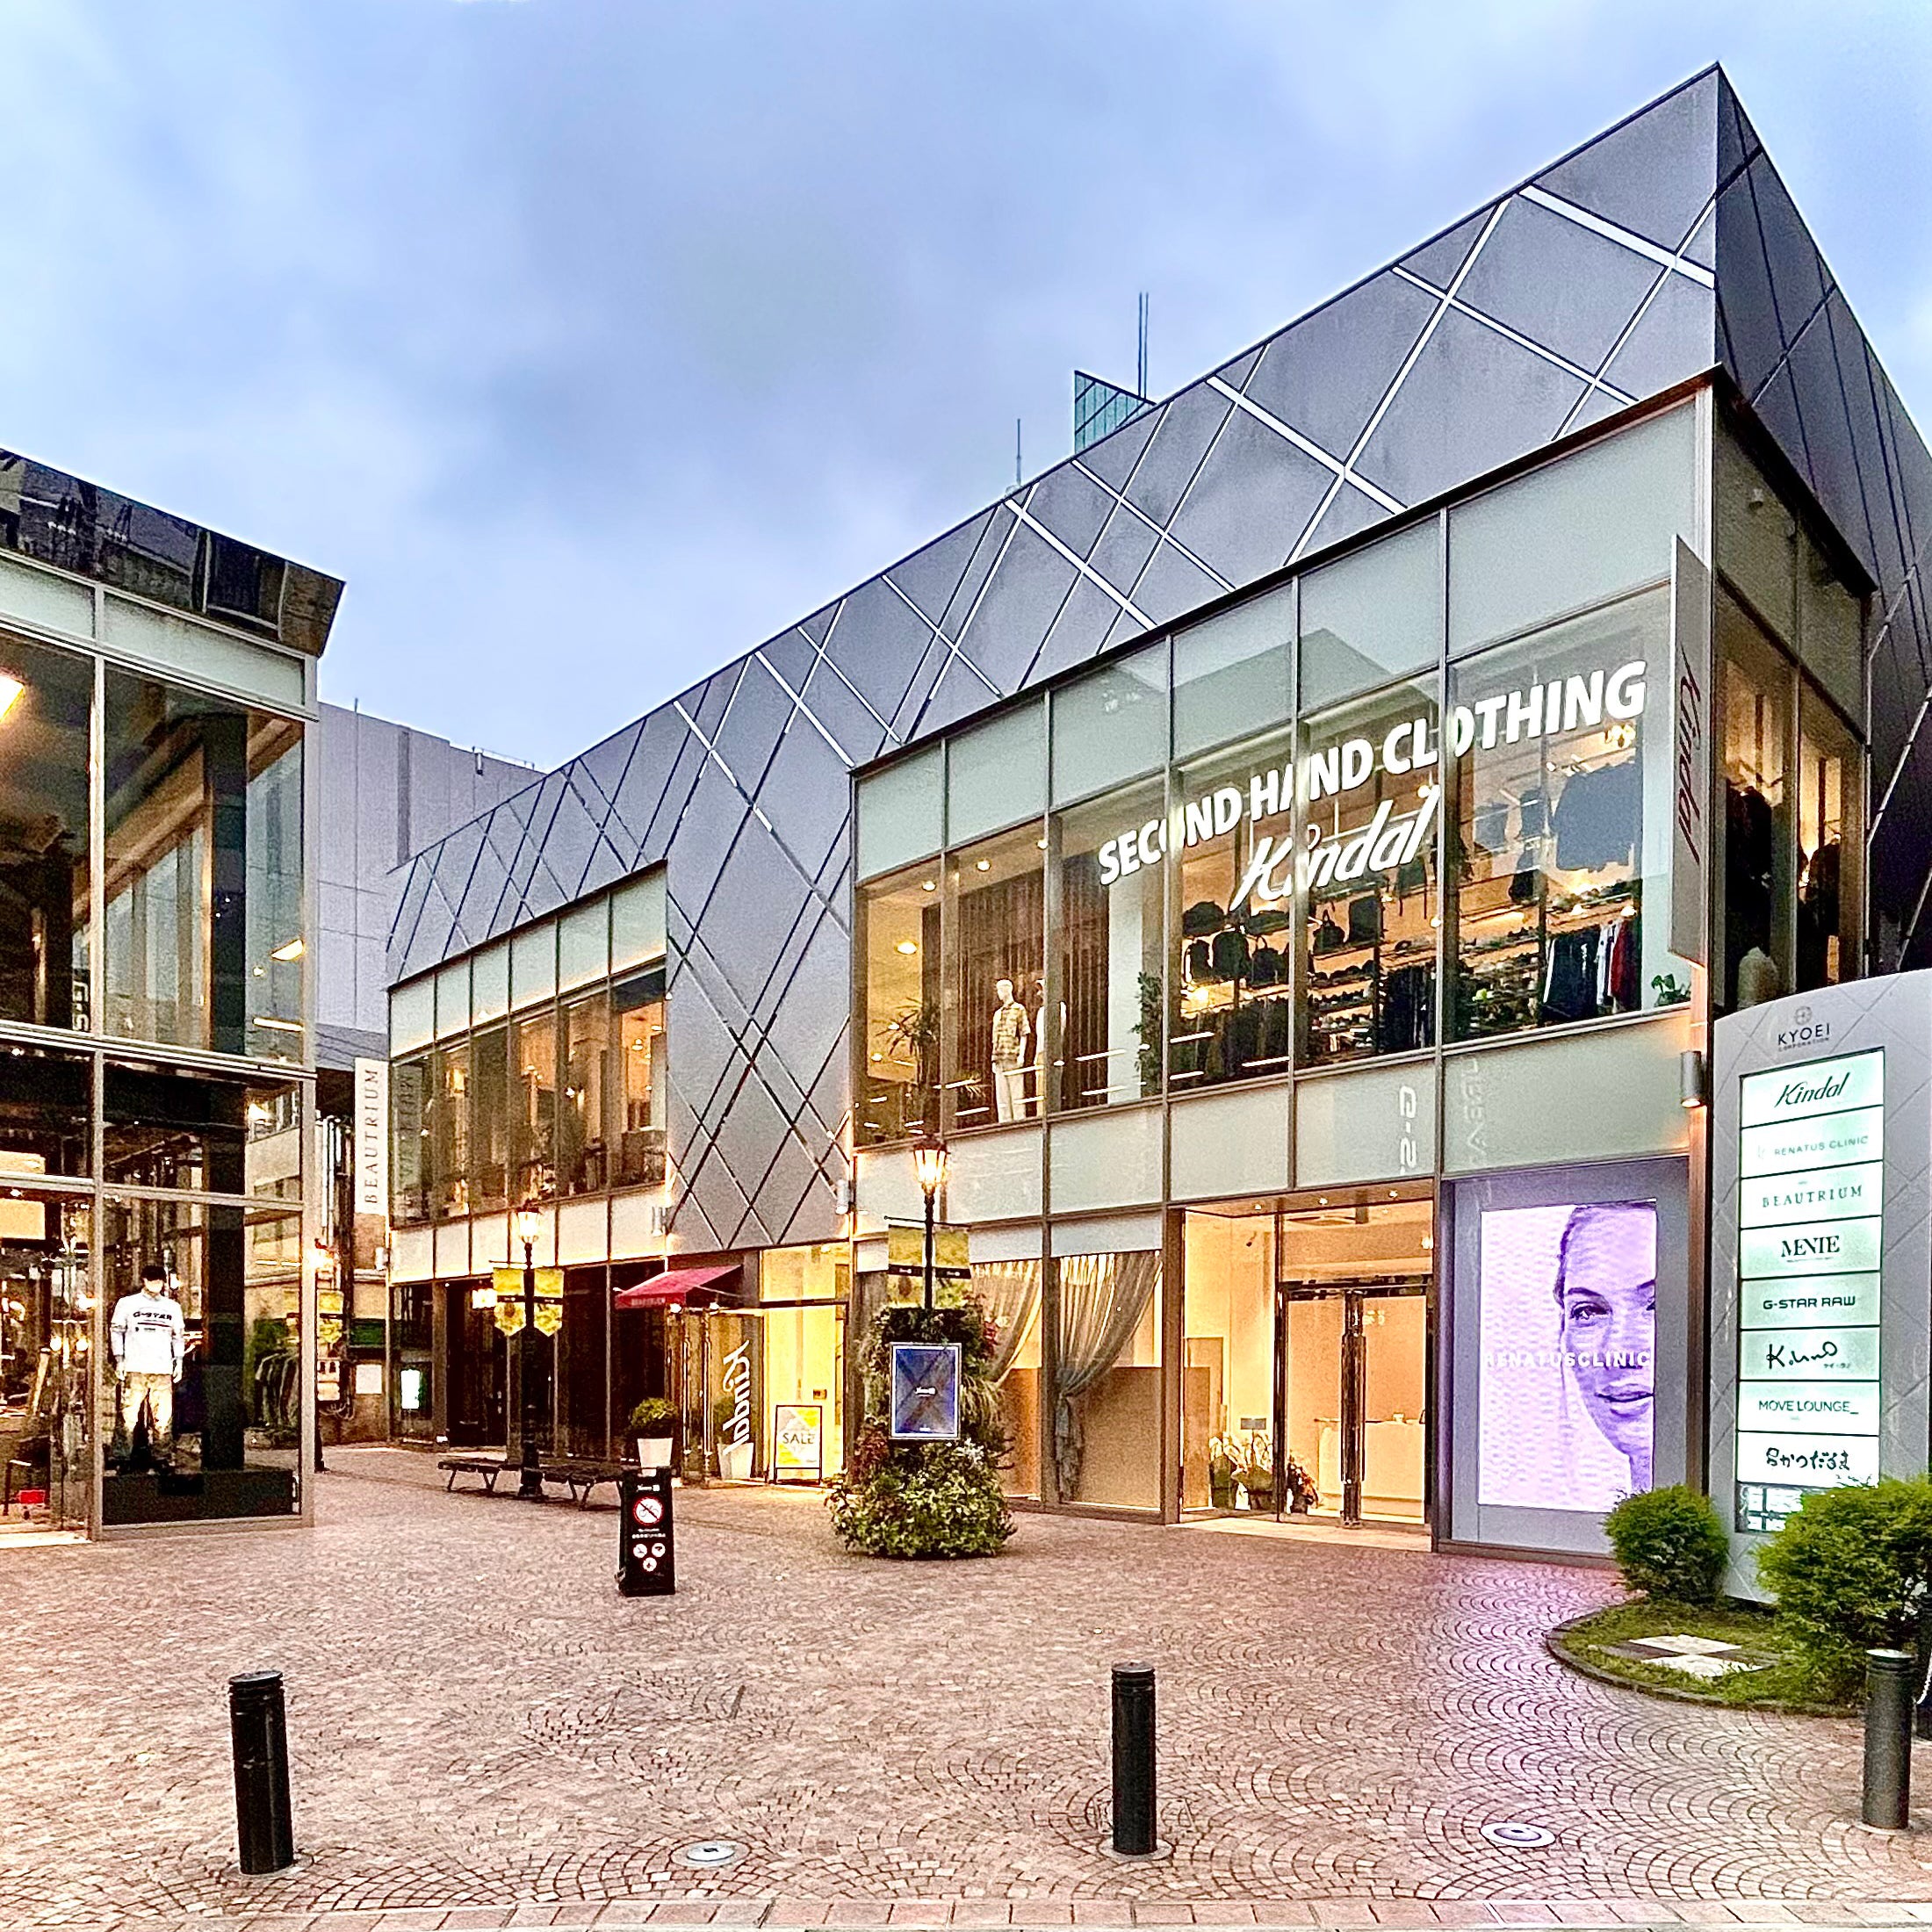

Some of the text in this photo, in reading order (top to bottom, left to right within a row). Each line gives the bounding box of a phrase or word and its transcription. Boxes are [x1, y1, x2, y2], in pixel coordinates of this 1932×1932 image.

[1678, 644, 1701, 866] Kindal
[1097, 660, 1648, 886] SECOND HAND CLOTHING
[1229, 783, 1440, 912] Kindal
[1777, 1022, 1831, 1046] KYOEI
[1774, 1071, 1851, 1108] Kindal
[364, 1070, 379, 1204] BEAUTRIUM
[1774, 1135, 1869, 1157] RENATUS CLINIC
[1762, 1184, 1863, 1208] BEAUTRIUM
[1763, 1295, 1856, 1310] G-STAR RAW
[1758, 1399, 1794, 1412] MOVE
[782, 1431, 816, 1445] SALE
